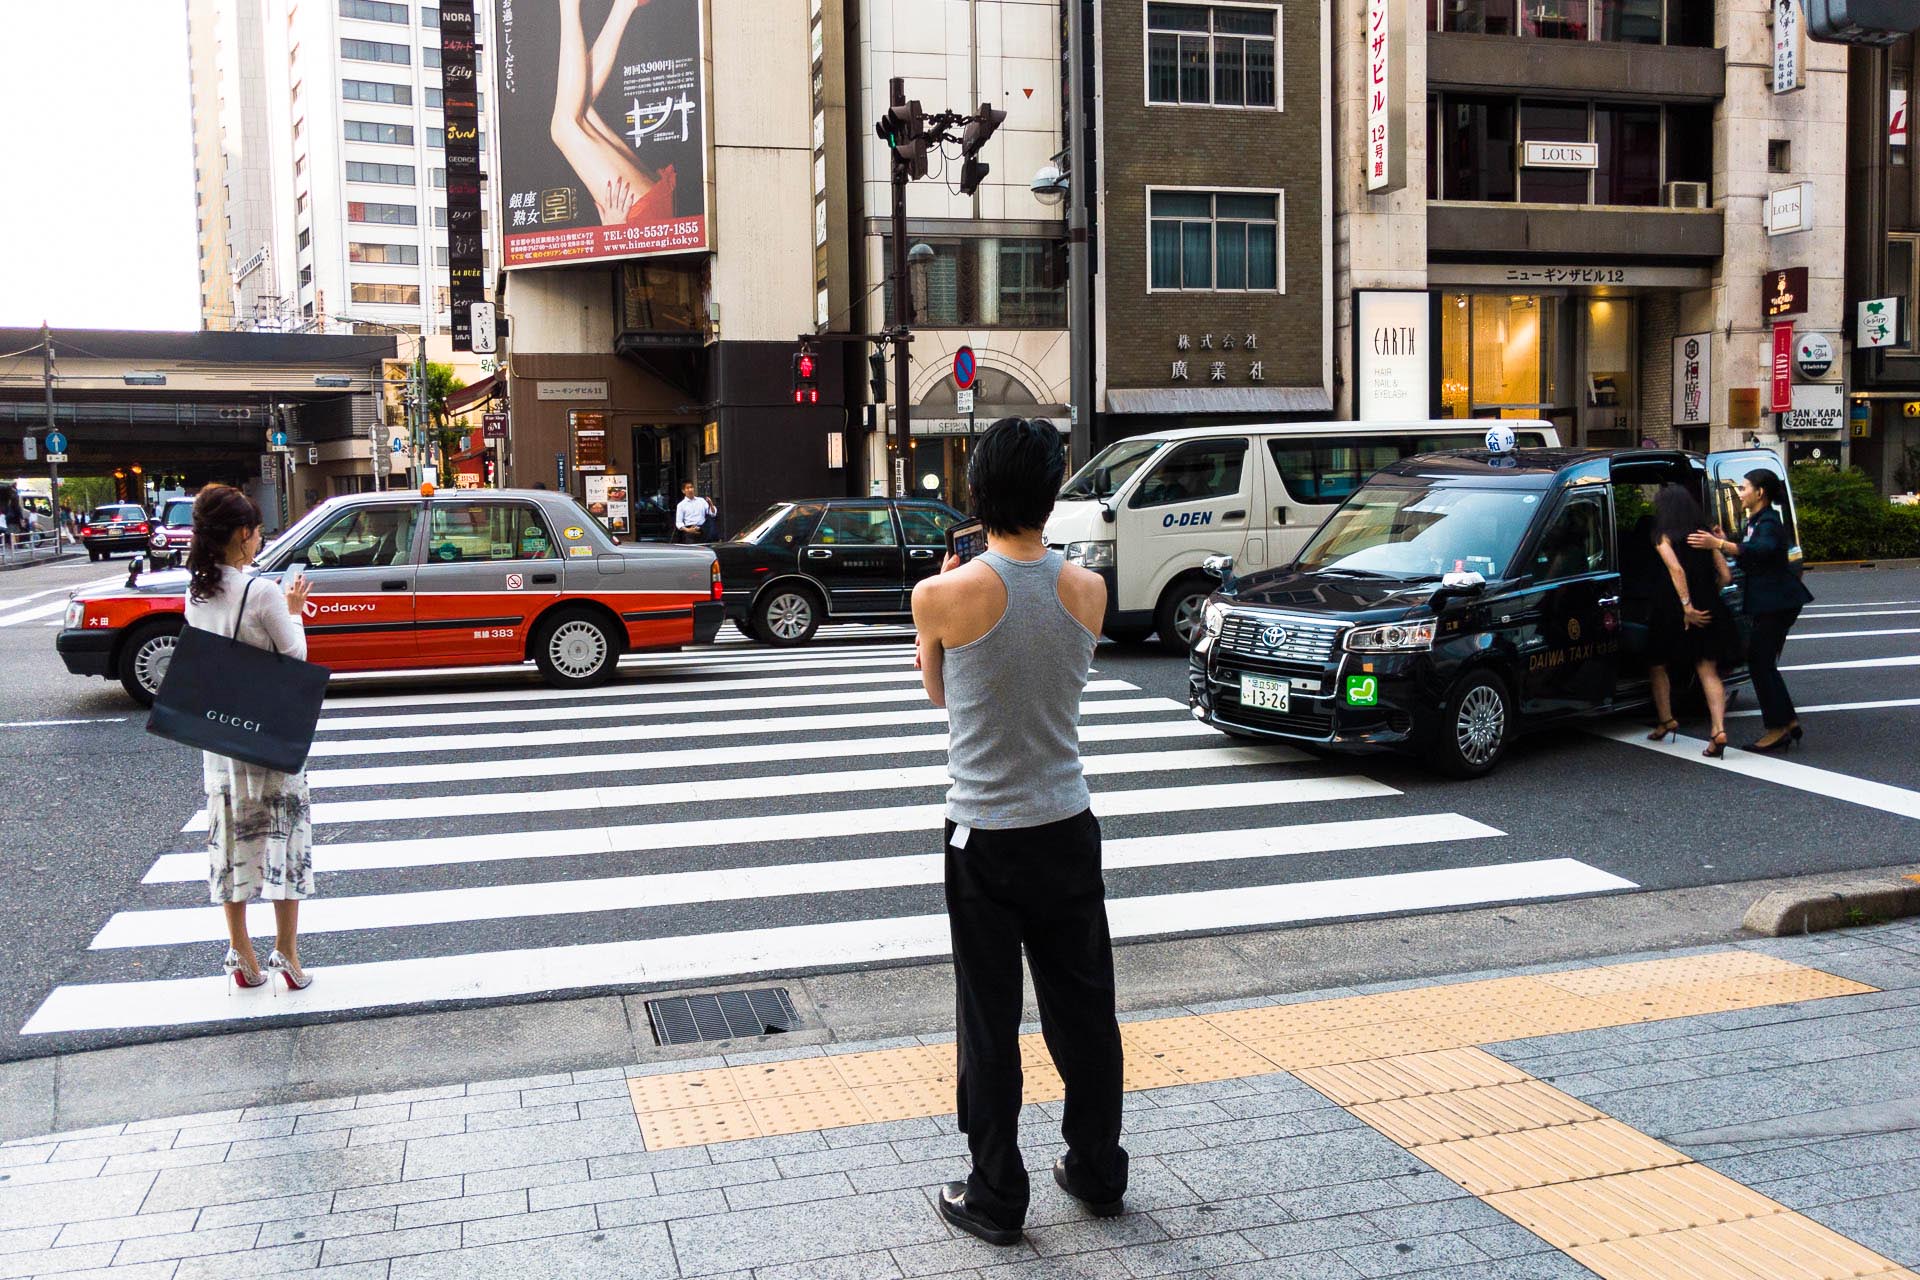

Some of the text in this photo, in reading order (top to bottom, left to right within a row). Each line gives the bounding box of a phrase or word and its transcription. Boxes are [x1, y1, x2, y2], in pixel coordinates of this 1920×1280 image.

[442, 12, 472, 22] NORA
[446, 65, 473, 79] Lily
[1542, 148, 1582, 161] LOUIS
[509, 190, 537, 209] 銀座
[1773, 201, 1800, 216] LOUIS
[512, 208, 540, 227] 熟女
[603, 221, 699, 241] TEL:03-5537-1855
[604, 236, 699, 251] www.himeragi.tokyo
[1507, 268, 1625, 282] ニューギンザビル12
[1177, 333, 1258, 350] 株式会社
[1374, 327, 1415, 355] EARTH
[1171, 360, 1264, 380] 廣業社
[1374, 368, 1392, 376] HAIR
[1374, 378, 1390, 387] NAIL
[1792, 418, 1834, 427] ZONE-GZ
[1487, 432, 1501, 451] 大和
[1162, 511, 1213, 528] O-DEN
[320, 602, 376, 613] odakyu
[89, 617, 109, 626] 大田
[491, 629, 514, 638] 383
[1529, 650, 1564, 670] DAIWA
[1570, 643, 1593, 661] TAXI
[1266, 681, 1279, 691] 530
[1252, 689, 1287, 709] 13-26
[206, 710, 260, 733] GUCCI
